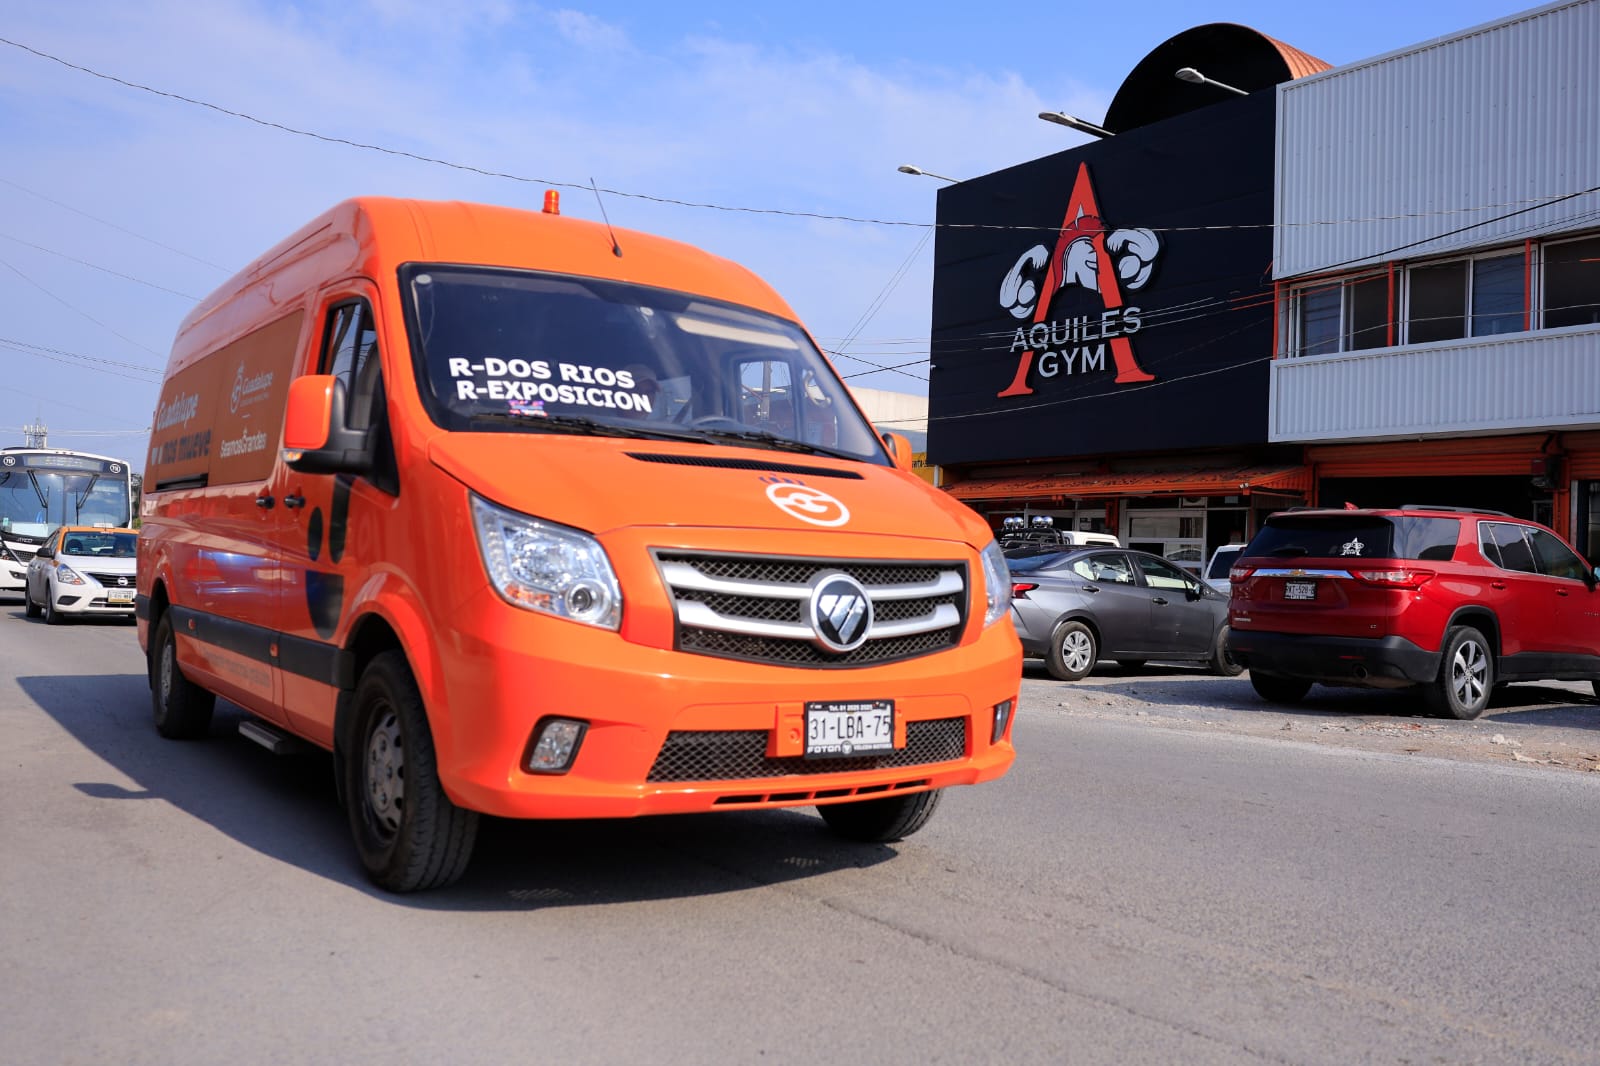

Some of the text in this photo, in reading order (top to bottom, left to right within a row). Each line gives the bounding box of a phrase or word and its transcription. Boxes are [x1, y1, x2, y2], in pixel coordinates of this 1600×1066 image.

[1009, 306, 1142, 353] AQUILES
[448, 357, 636, 389] R-DOS RIOS
[1038, 344, 1105, 378] GYM
[456, 380, 652, 413] R-EXPOSICION
[810, 715, 891, 740] 31-LBA-75
